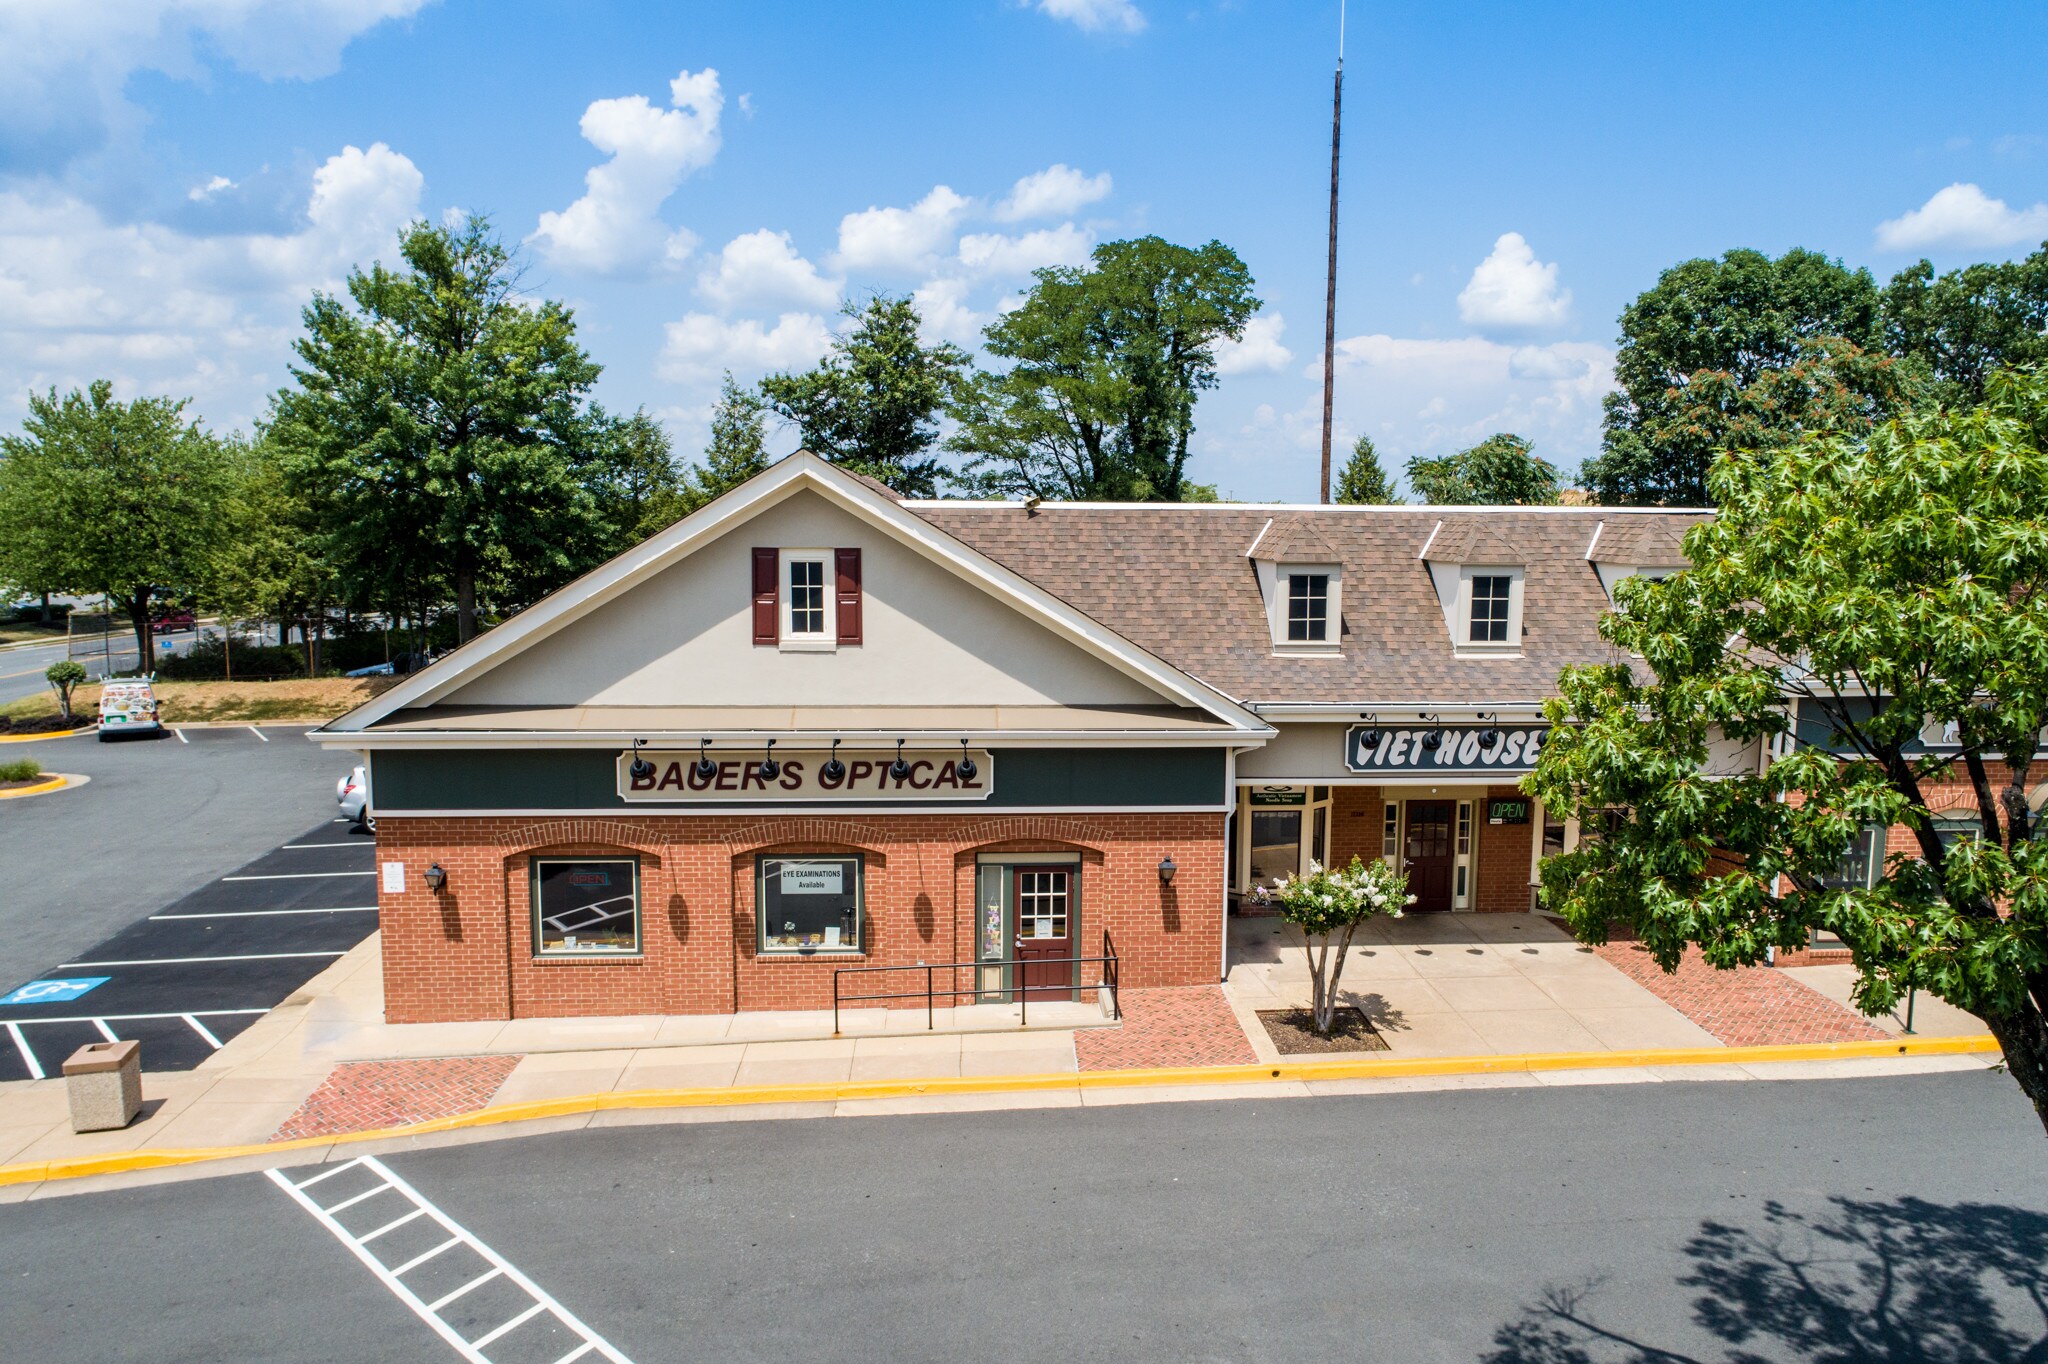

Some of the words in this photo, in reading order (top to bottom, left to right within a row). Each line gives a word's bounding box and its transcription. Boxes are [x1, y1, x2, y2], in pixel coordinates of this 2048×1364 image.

[1356, 730, 1429, 766] VIET
[1434, 730, 1544, 766] HOUSE
[630, 761, 804, 791] BAUERS
[1492, 802, 1525, 818] OPEN
[569, 874, 605, 884] OPEN
[782, 870, 795, 878] EYE
[796, 870, 841, 878] EXAMINATIONS
[798, 881, 826, 889] Available
